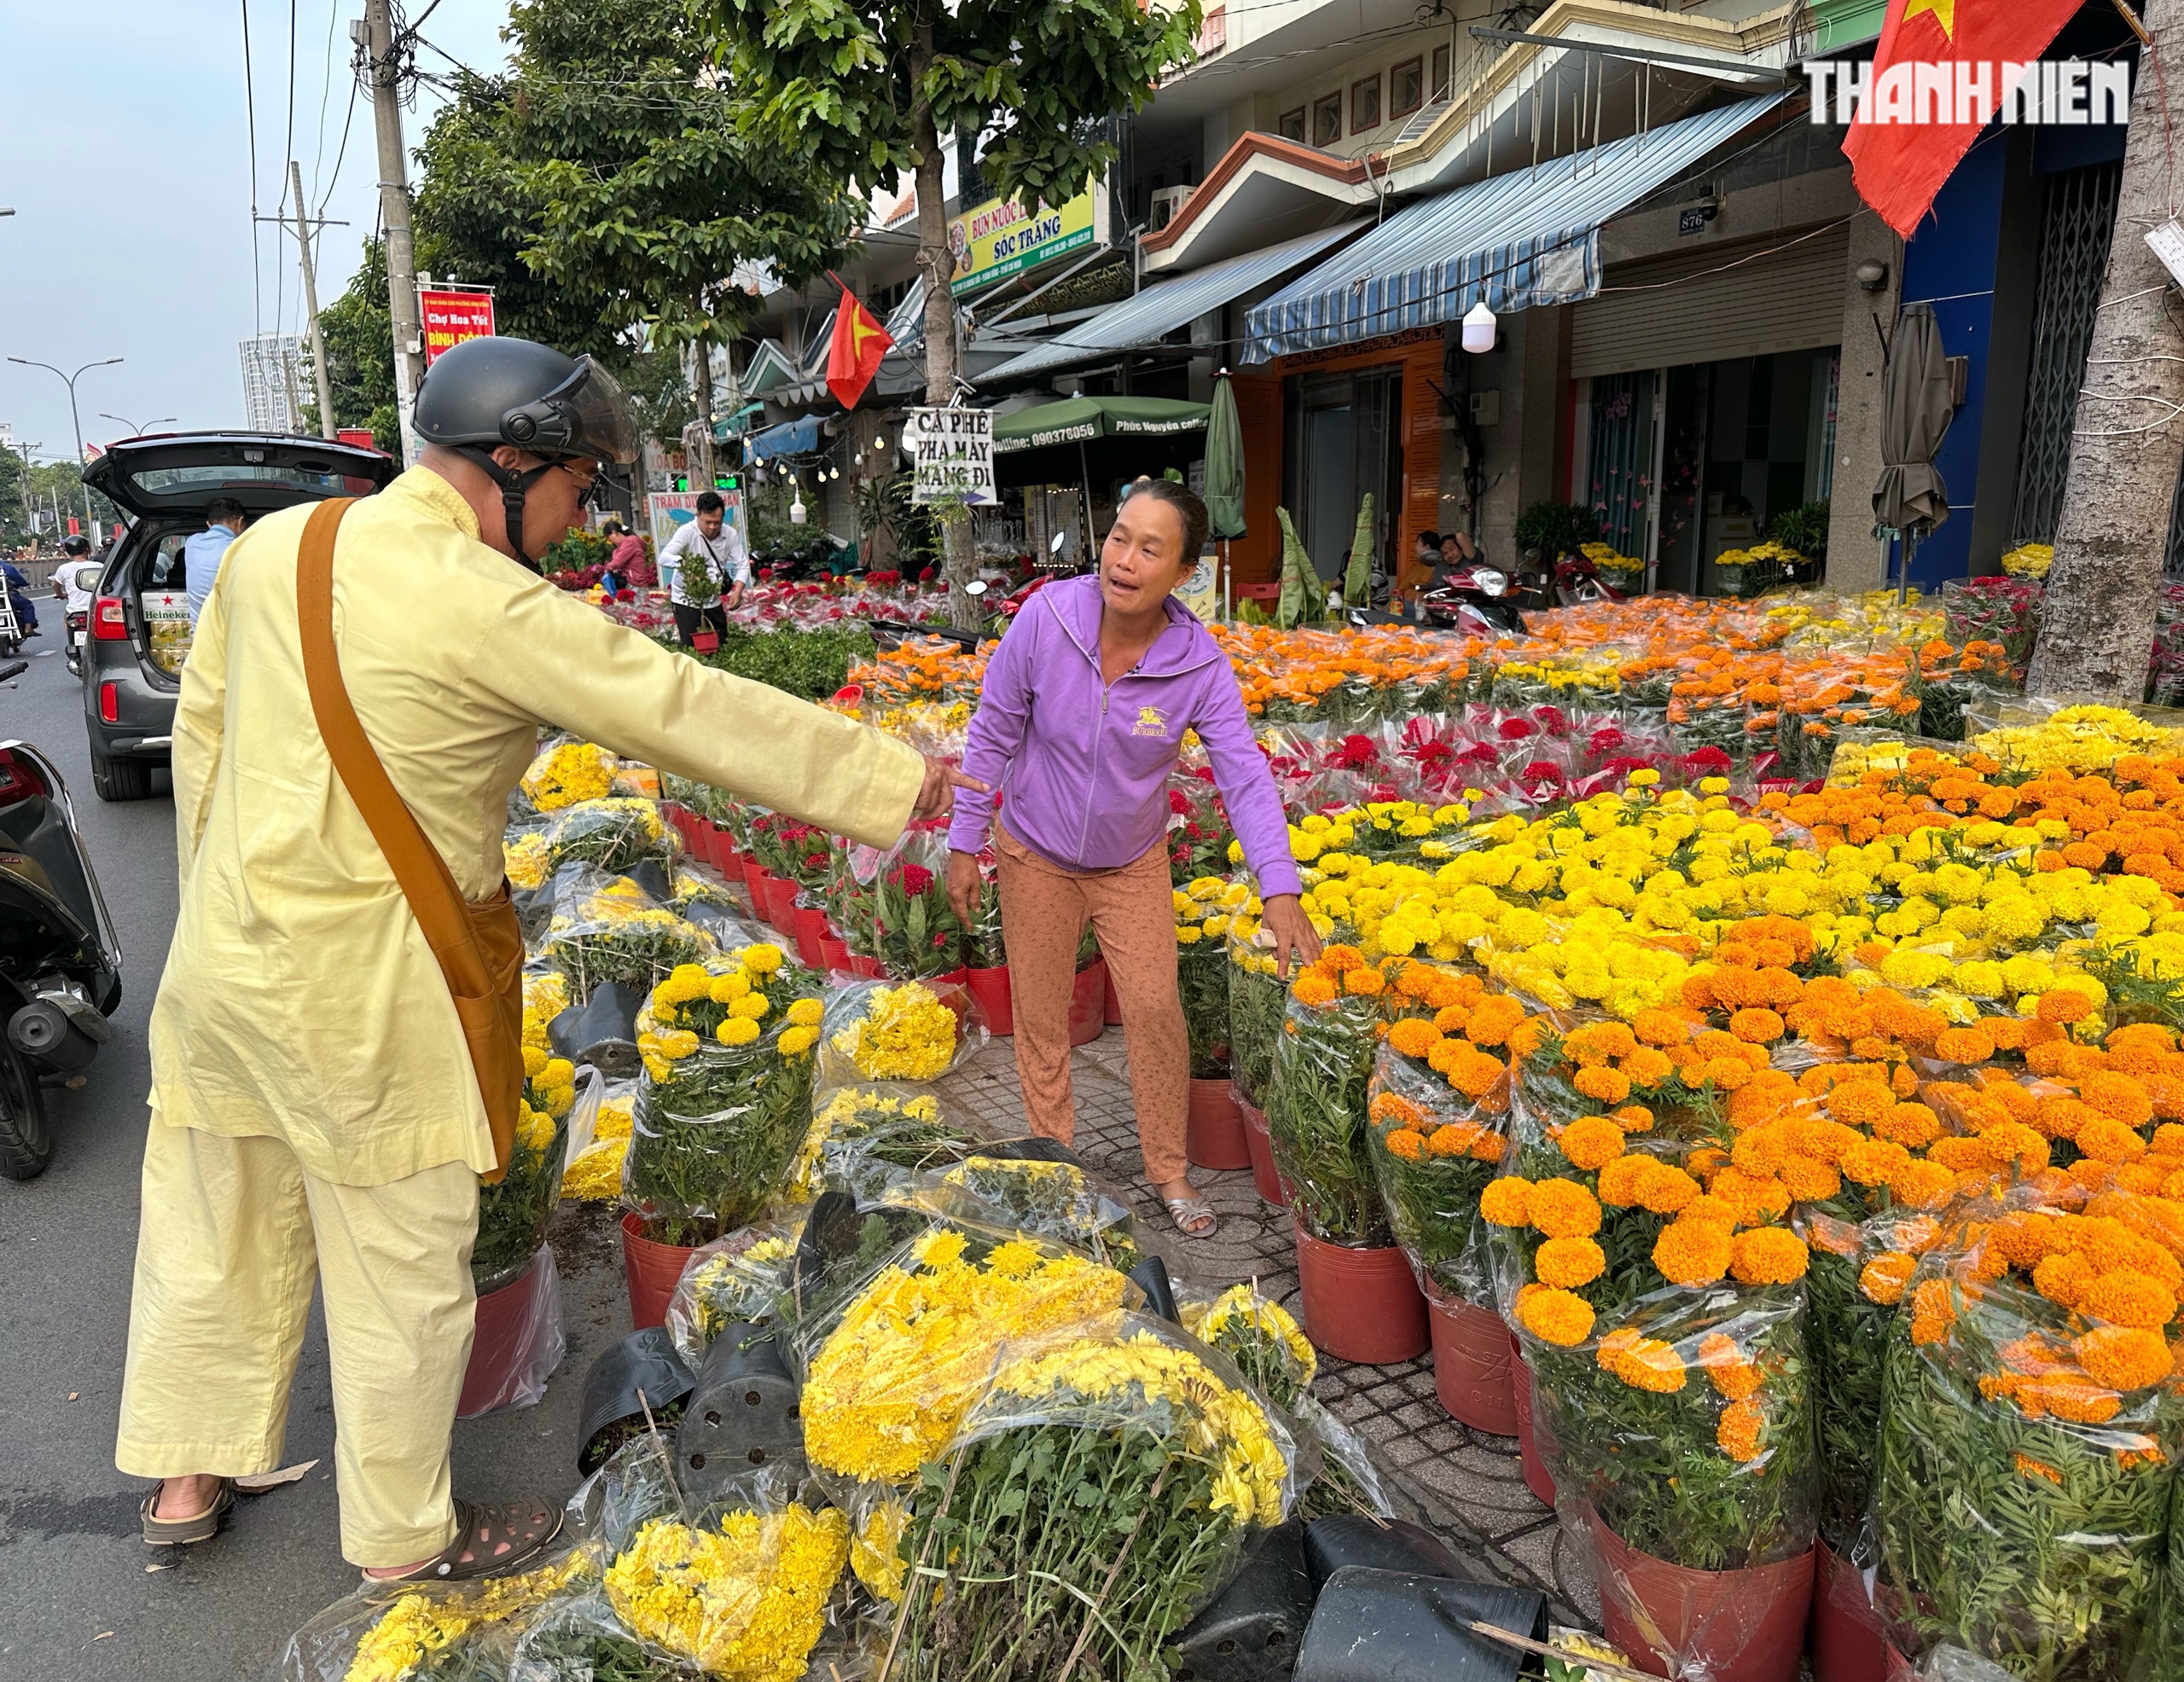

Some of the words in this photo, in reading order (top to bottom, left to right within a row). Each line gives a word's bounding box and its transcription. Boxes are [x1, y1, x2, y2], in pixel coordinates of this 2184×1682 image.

[972, 212, 990, 240] BÚN
[1682, 214, 1703, 229] 876
[994, 233, 1016, 259] SÓC
[1019, 215, 1061, 252] TRĂNG
[428, 313, 448, 326] Chợ
[450, 314, 470, 325] Hoa
[471, 315, 489, 326] Tết
[428, 329, 456, 347] BÌNH
[950, 410, 989, 435] PHÊ
[1116, 420, 1142, 432] Phúc
[1142, 421, 1180, 432] Nguyên
[1181, 417, 1209, 430] coffee
[1031, 423, 1095, 447] 090378056
[918, 440, 949, 460] PHA
[973, 467, 991, 486] ĐI
